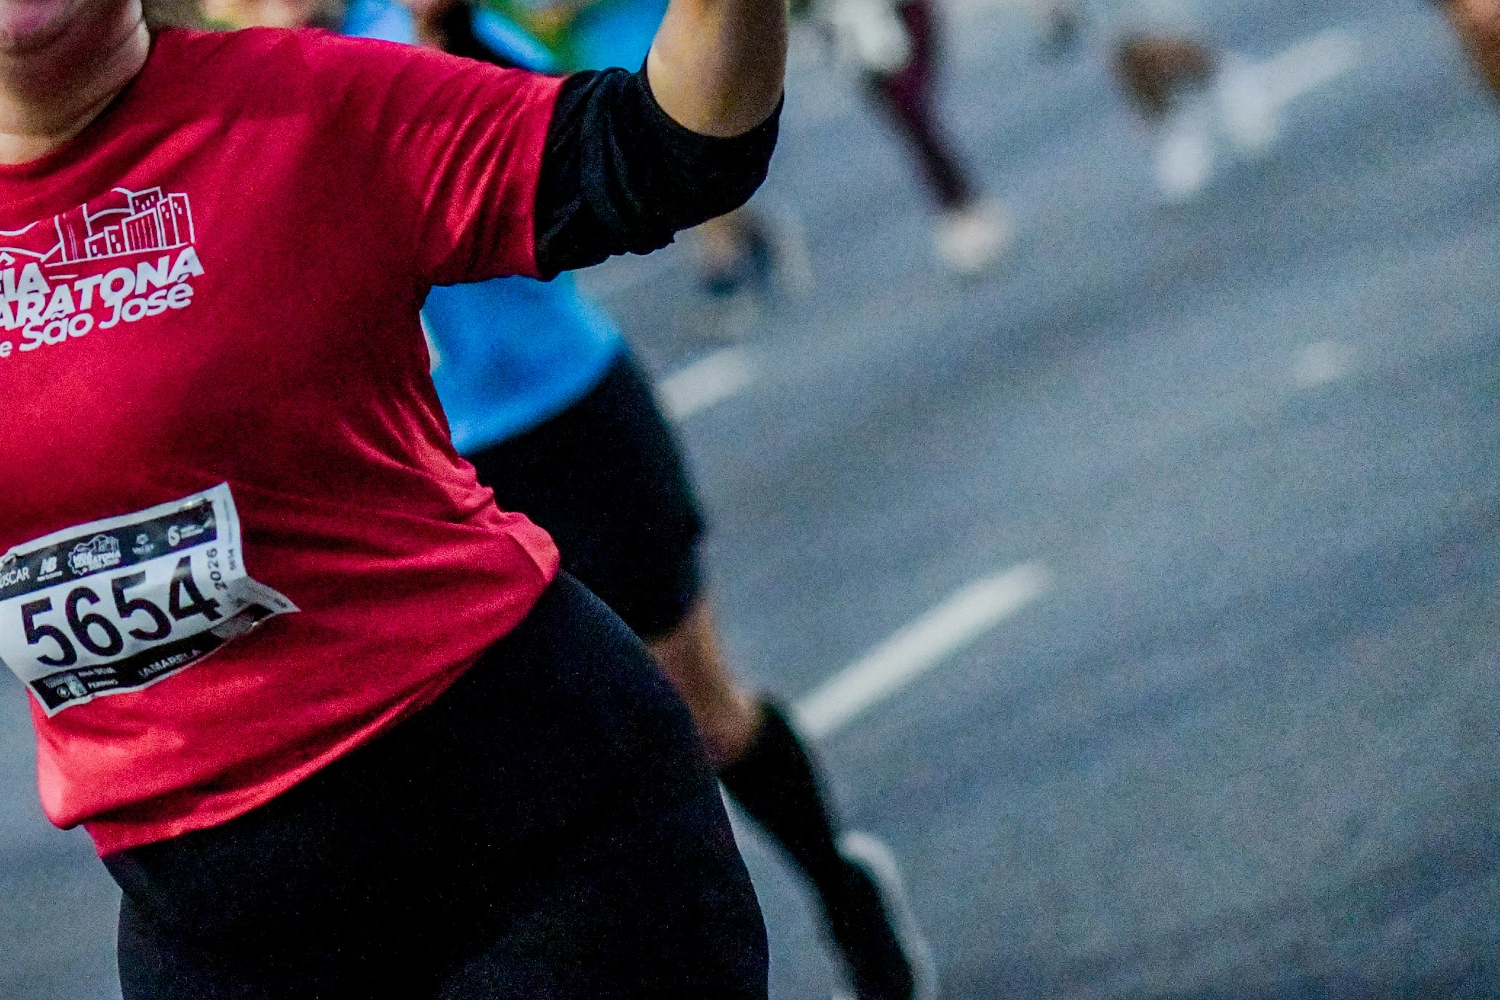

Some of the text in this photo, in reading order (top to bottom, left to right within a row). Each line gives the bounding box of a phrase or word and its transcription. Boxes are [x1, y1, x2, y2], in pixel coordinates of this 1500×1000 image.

[19, 310, 93, 352] São
[98, 275, 195, 330] José
[0, 568, 30, 588] OSCAR
[20, 555, 223, 668] 5654
